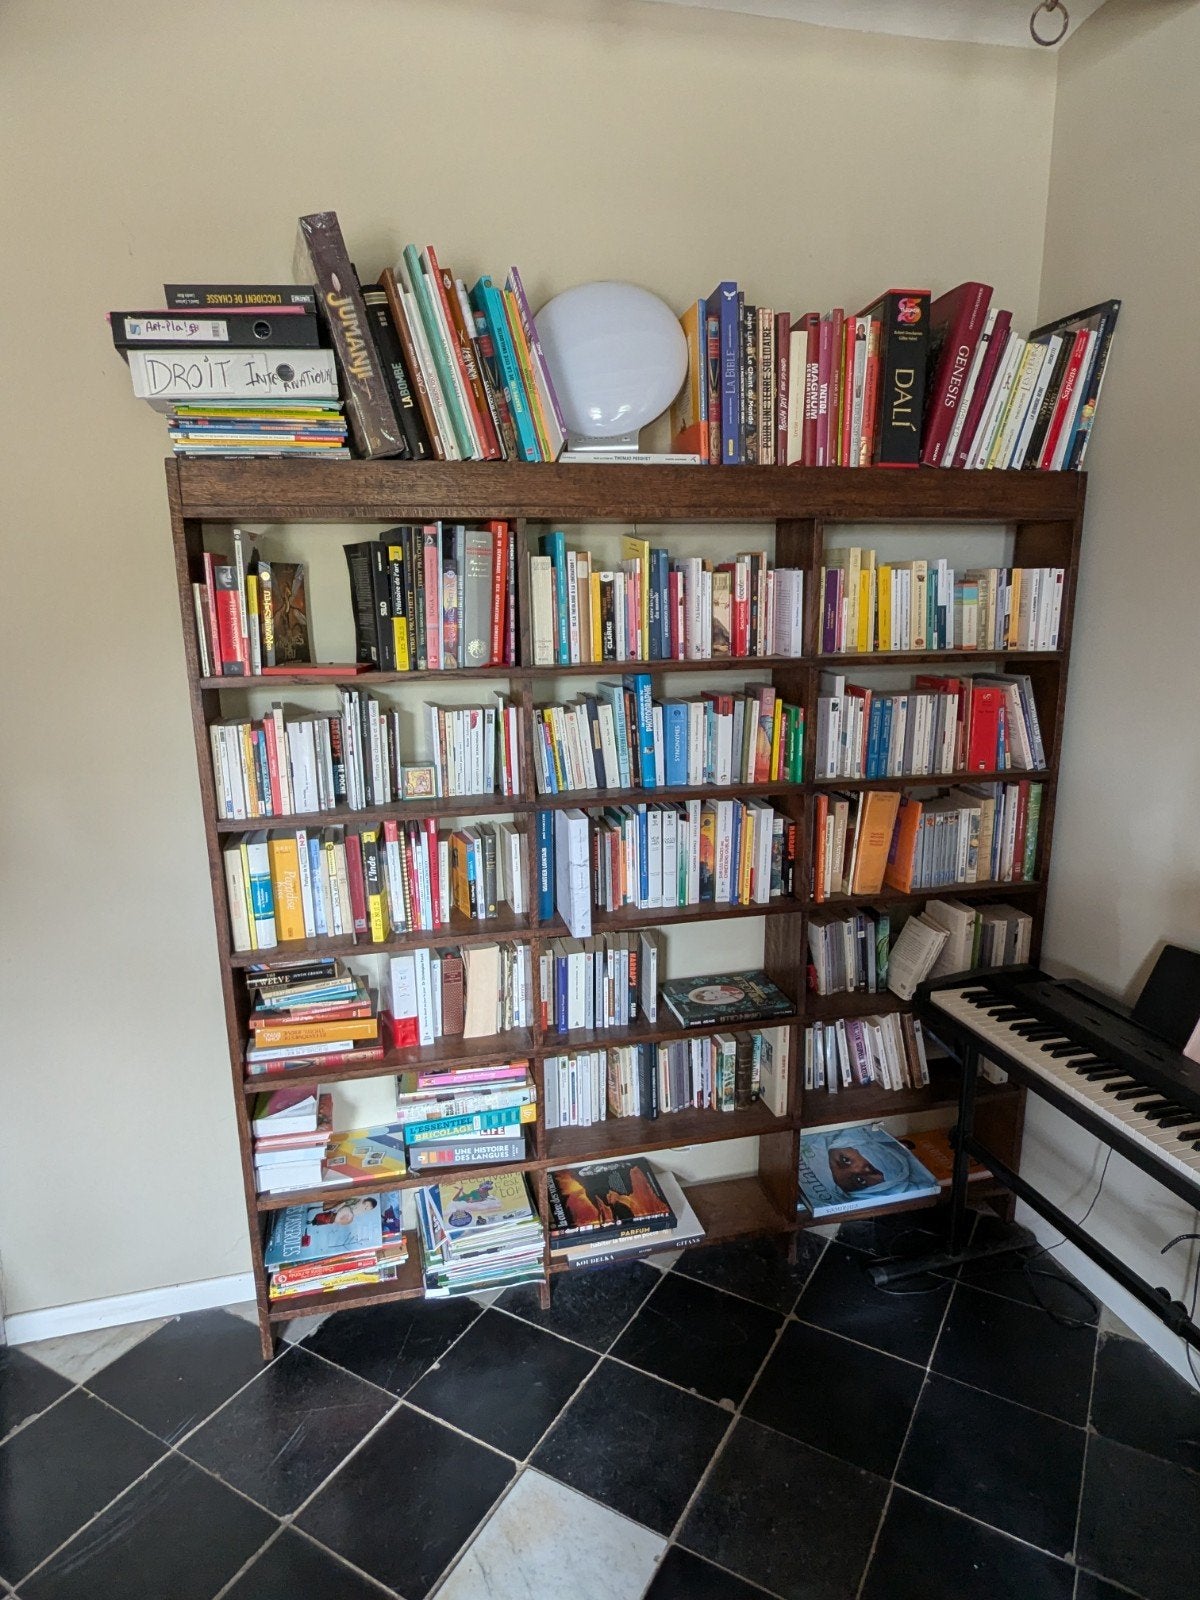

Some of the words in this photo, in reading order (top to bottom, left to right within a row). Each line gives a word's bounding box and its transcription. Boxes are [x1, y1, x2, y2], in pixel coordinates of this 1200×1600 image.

[206, 294, 233, 304] CHASSE
[234, 294, 243, 304] DE
[245, 294, 282, 304] L'ACCIDENT
[746, 312, 754, 329] Jean
[325, 292, 376, 381] JUMANJI
[747, 355, 754, 364] Le
[761, 326, 772, 373] SOLIDAIRE
[725, 350, 735, 378] BIBLE
[944, 345, 970, 408] GENESIS
[725, 381, 736, 394] LA
[762, 375, 772, 403] TERRE
[810, 363, 819, 419] MAGNUM
[1061, 366, 1077, 401] Sapiens
[819, 383, 828, 414] POLINA
[892, 368, 917, 432] DALÍ
[747, 400, 755, 425] Monde
[762, 405, 772, 422] UNE
[762, 423, 772, 449] POUR
[394, 577, 401, 585] de
[394, 586, 402, 615] L'Histoire
[407, 590, 415, 631] PRATCHETT
[408, 632, 416, 654] TERRY
[330, 719, 342, 758] HARRAP'S
[338, 764, 345, 772] DE
[338, 773, 346, 794] POCHE
[787, 825, 796, 860] HARRAP'S
[366, 855, 378, 882] L'Inde
[629, 953, 637, 987] HARRAP'S
[410, 1116, 473, 1134] L'ESSENTIEL
[454, 1147, 472, 1155] UNE
[474, 1145, 509, 1153] HISTOIRE
[471, 1152, 509, 1160] LANGUES
[620, 1227, 651, 1237] PARFUM
